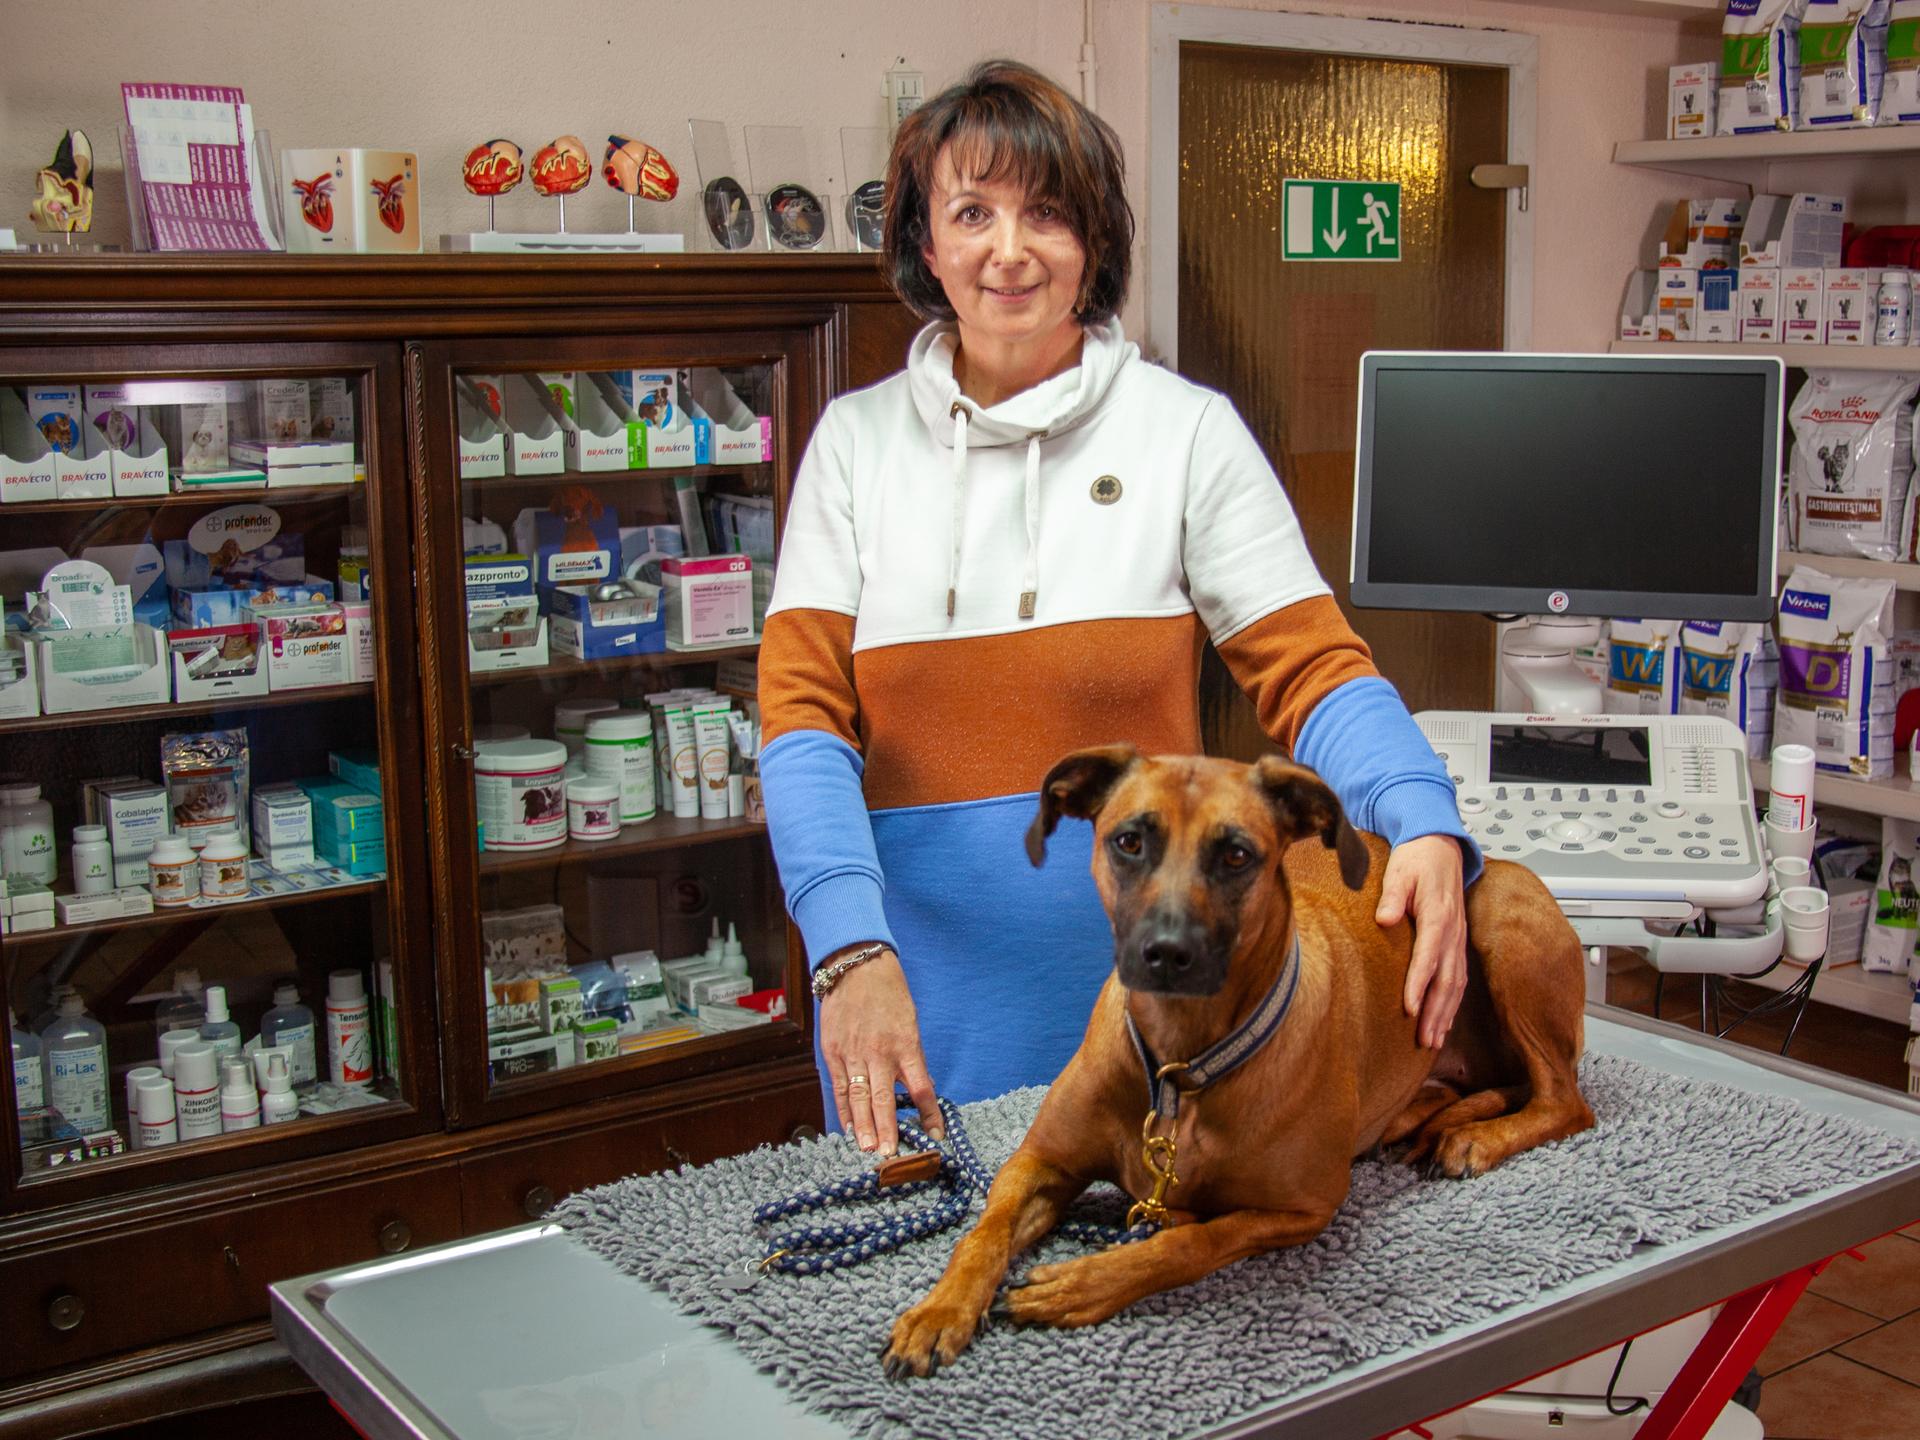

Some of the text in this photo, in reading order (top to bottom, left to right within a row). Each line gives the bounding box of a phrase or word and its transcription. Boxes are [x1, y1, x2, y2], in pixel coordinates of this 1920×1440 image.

[1819, 31, 1849, 58] U
[266, 382, 305, 394] Credelio
[1811, 408, 1881, 420] ROYAL CANIN
[586, 446, 624, 457] BRAVECTO
[654, 443, 691, 454] BRAVECTO
[721, 440, 757, 451] BRAVECTO
[520, 448, 559, 461] BRAVECTO
[5, 472, 52, 486] BRAVECTO
[61, 471, 107, 484] BRAVECTO
[120, 469, 165, 481] BRAVECTO
[1807, 499, 1878, 513] GASTROINTESTINAL
[225, 514, 272, 532] profender
[466, 569, 525, 584] azppronto®
[1786, 594, 1828, 611] Virbac
[303, 641, 342, 657] profender
[1620, 650, 1659, 681] W
[1690, 655, 1728, 688] W
[1805, 656, 1840, 692] D
[1817, 711, 1845, 723] HPM
[115, 806, 165, 820] Cobalaplex
[55, 1062, 97, 1077] Ri-Lac
[16, 1075, 29, 1086] ac
